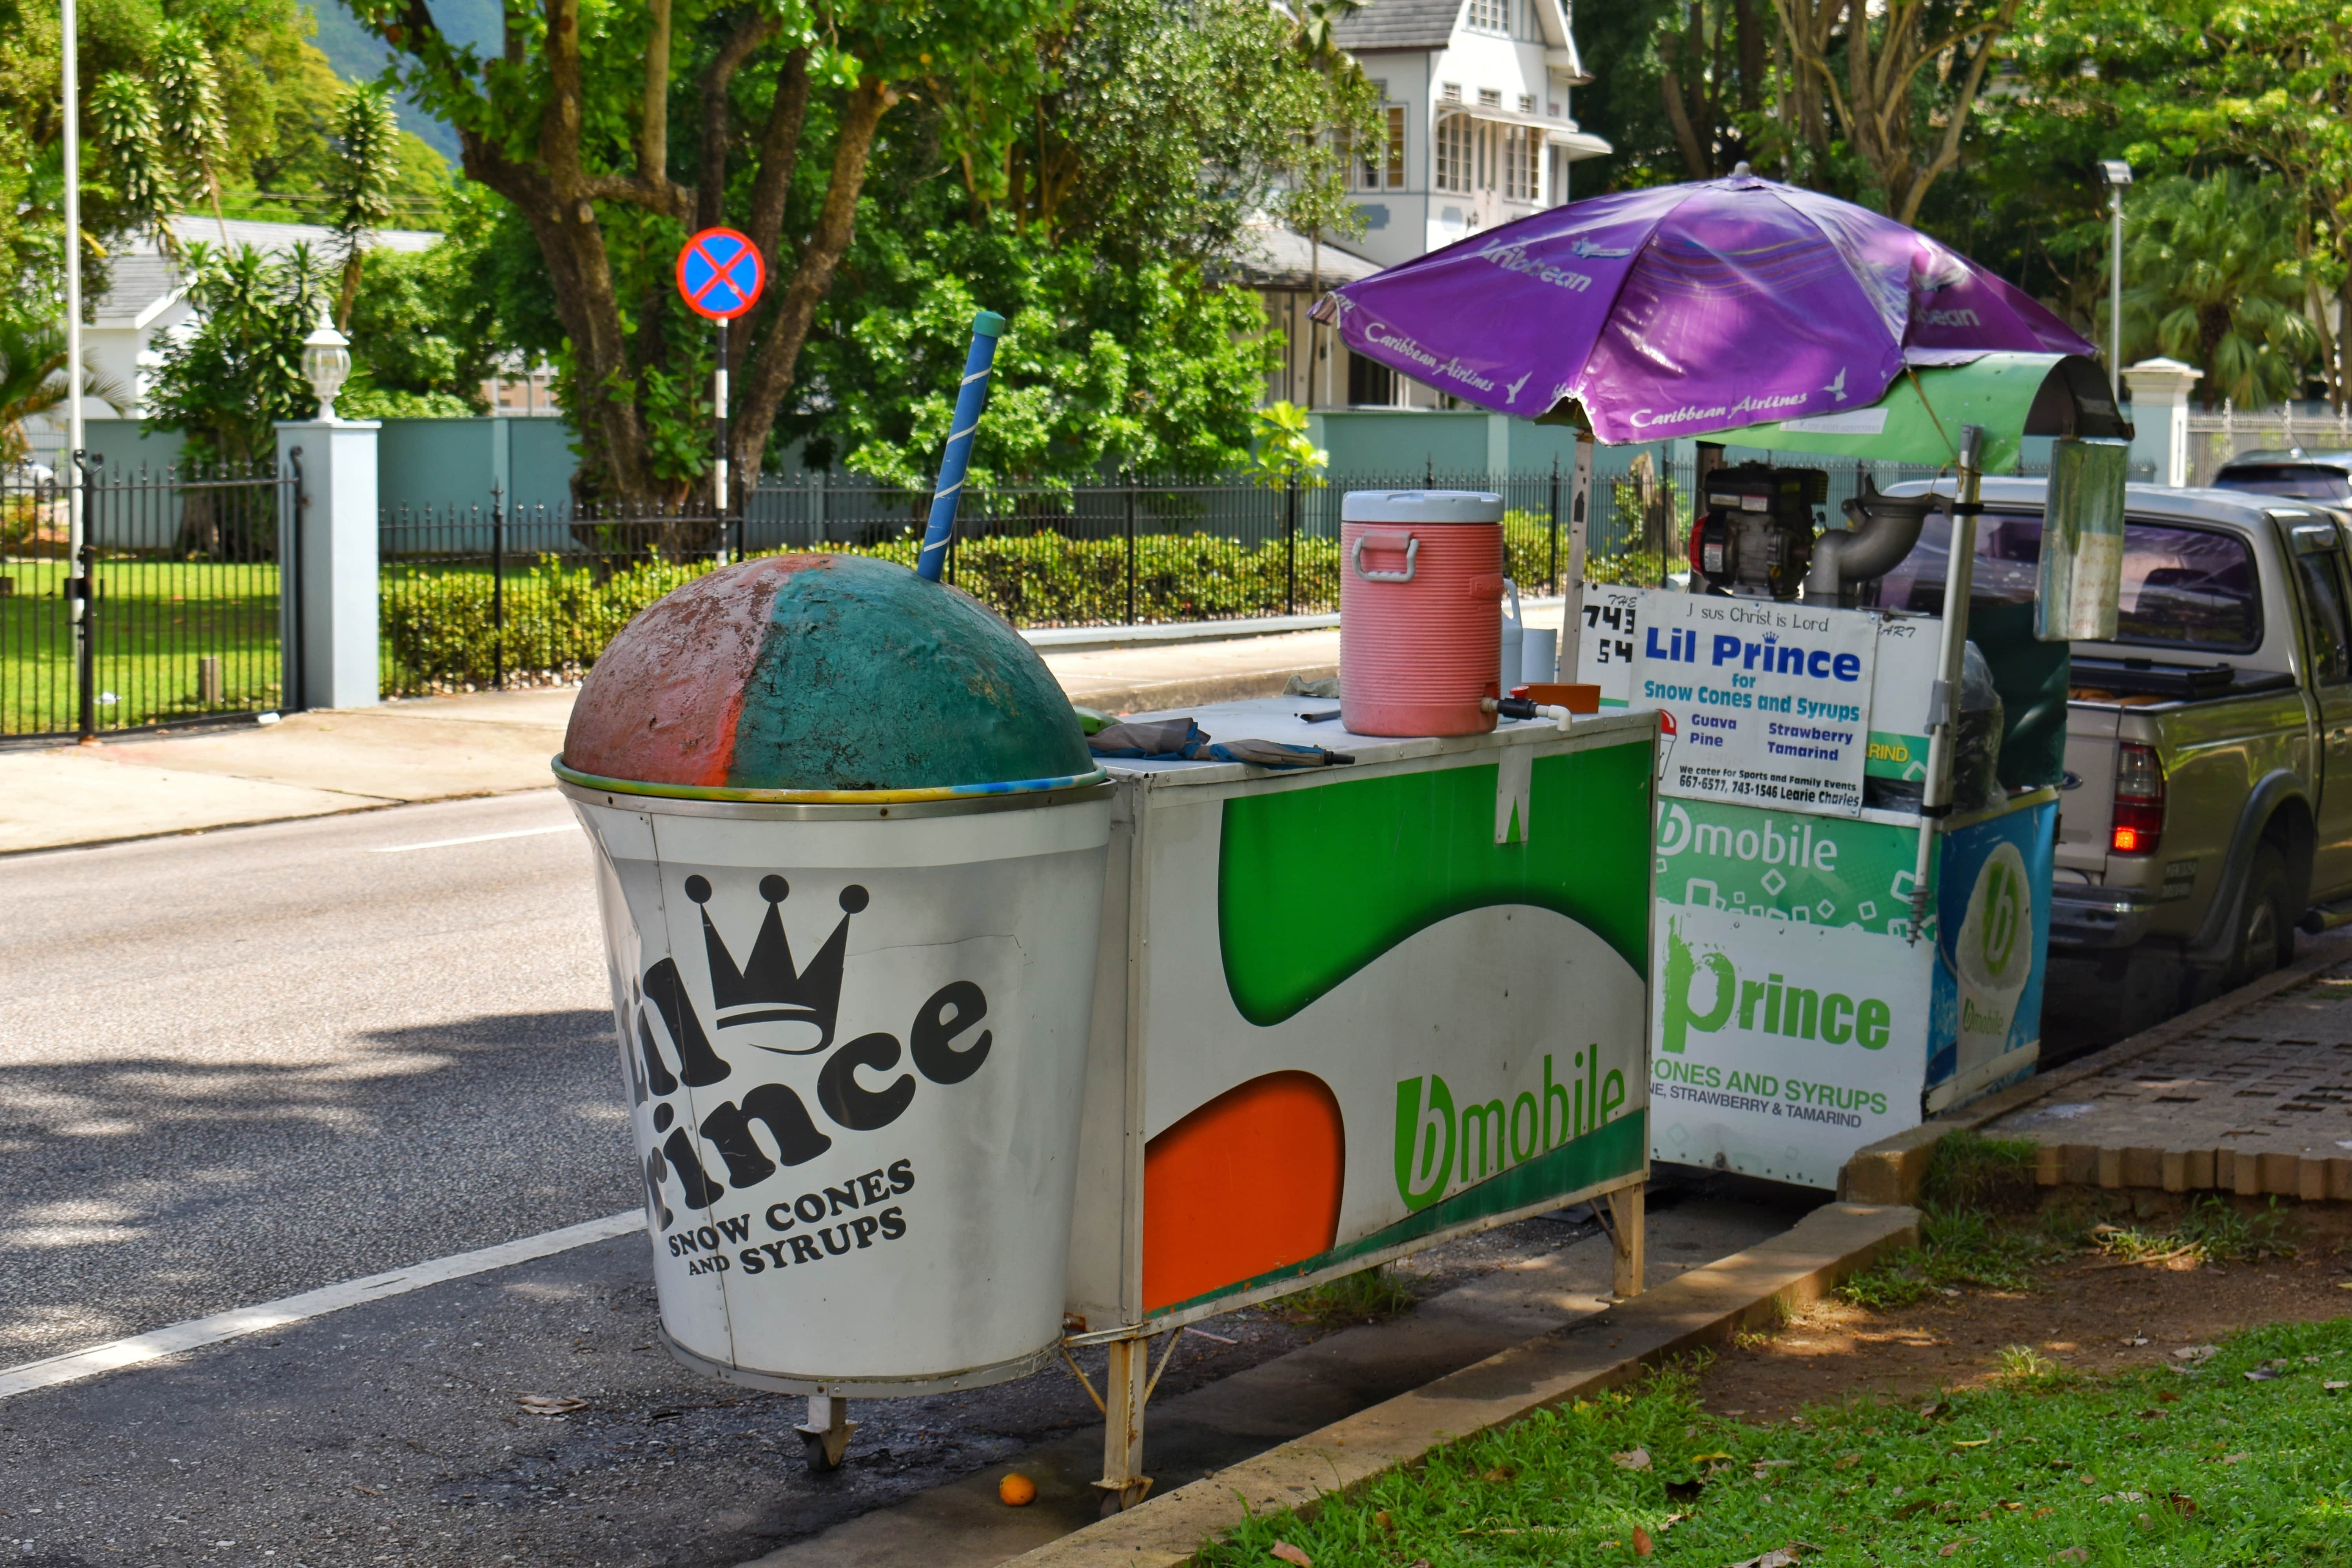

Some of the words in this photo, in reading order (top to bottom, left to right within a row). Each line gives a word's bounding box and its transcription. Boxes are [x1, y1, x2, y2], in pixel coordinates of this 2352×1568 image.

[1364, 323, 1436, 368] Caribbean
[1432, 358, 1494, 392] Airlines
[1629, 405, 1726, 428] Caribbean
[1728, 392, 1807, 419] Airlines
[1608, 594, 1637, 608] THE
[1730, 607, 1771, 626] Christ
[1777, 613, 1787, 627] is
[1792, 614, 1829, 632] Lord
[1645, 626, 1697, 663] Lil
[1712, 632, 1861, 682] Prince
[1732, 673, 1756, 688] for
[1644, 680, 1693, 702] Snow
[1697, 686, 1752, 709] Cones
[1757, 695, 1792, 713] and
[1797, 697, 1860, 723] Syrups
[1691, 714, 1737, 730] Guava
[1768, 722, 1854, 745] Strawberry
[1690, 732, 1723, 747] Pine
[1767, 742, 1839, 761] Tamarind
[1679, 765, 1693, 774] We
[1696, 767, 1720, 776] cater
[1723, 768, 1737, 777] for
[1739, 769, 1768, 781] Sports
[1770, 775, 1787, 783] and
[1789, 776, 1822, 788] Family
[1824, 780, 1857, 791] Events
[1731, 781, 1778, 799] 743-1546
[1780, 786, 1815, 803] Learie
[1818, 791, 1860, 807] Charles
[1651, 1058, 1721, 1088] ONES
[1725, 1071, 1779, 1098] AND
[1784, 1079, 1887, 1115] SYRUPS
[639, 979, 993, 1232] rince
[1670, 1085, 1769, 1113] STRAWBERRY
[1771, 1103, 1782, 1116] &
[1785, 1104, 1862, 1128] TAMARIND
[668, 1213, 751, 1257] SNOW
[765, 1158, 915, 1232] CONES
[688, 1254, 730, 1275] AND
[739, 1206, 907, 1275] SYRUPS
